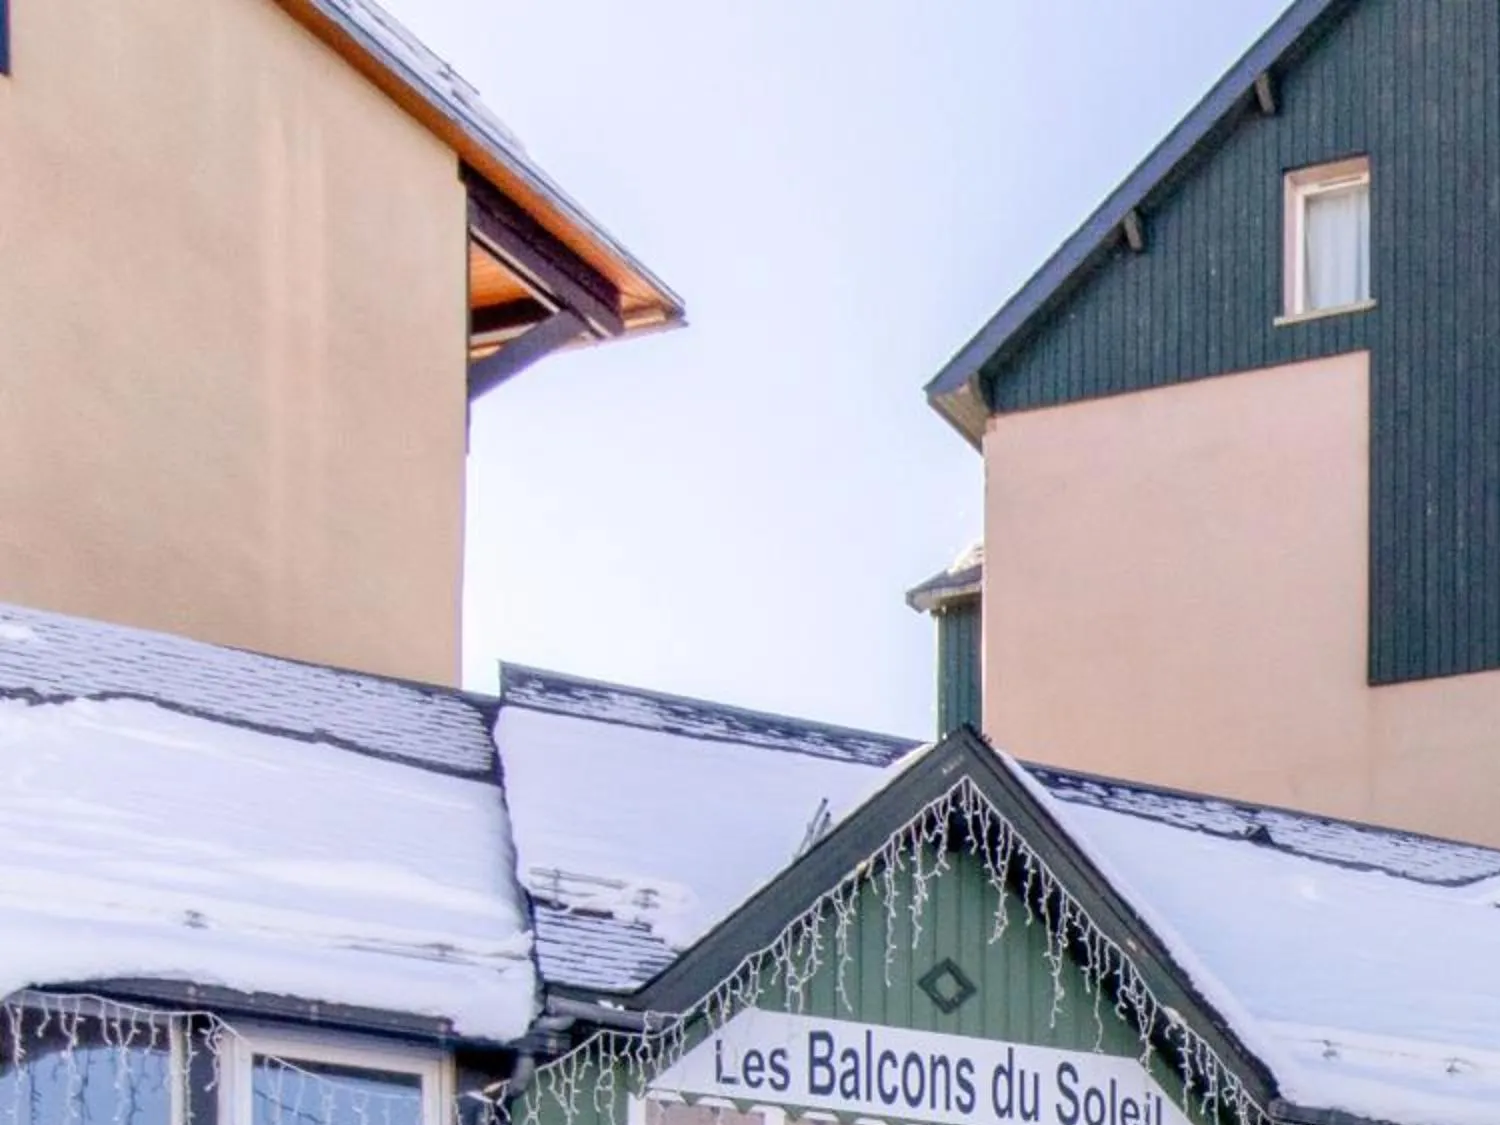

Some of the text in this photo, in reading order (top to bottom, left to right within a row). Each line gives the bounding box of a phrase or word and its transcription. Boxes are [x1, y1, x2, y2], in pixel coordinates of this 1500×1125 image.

[715, 1039, 791, 1092] Les
[808, 1029, 976, 1115] Balcons
[991, 1047, 1040, 1122] du
